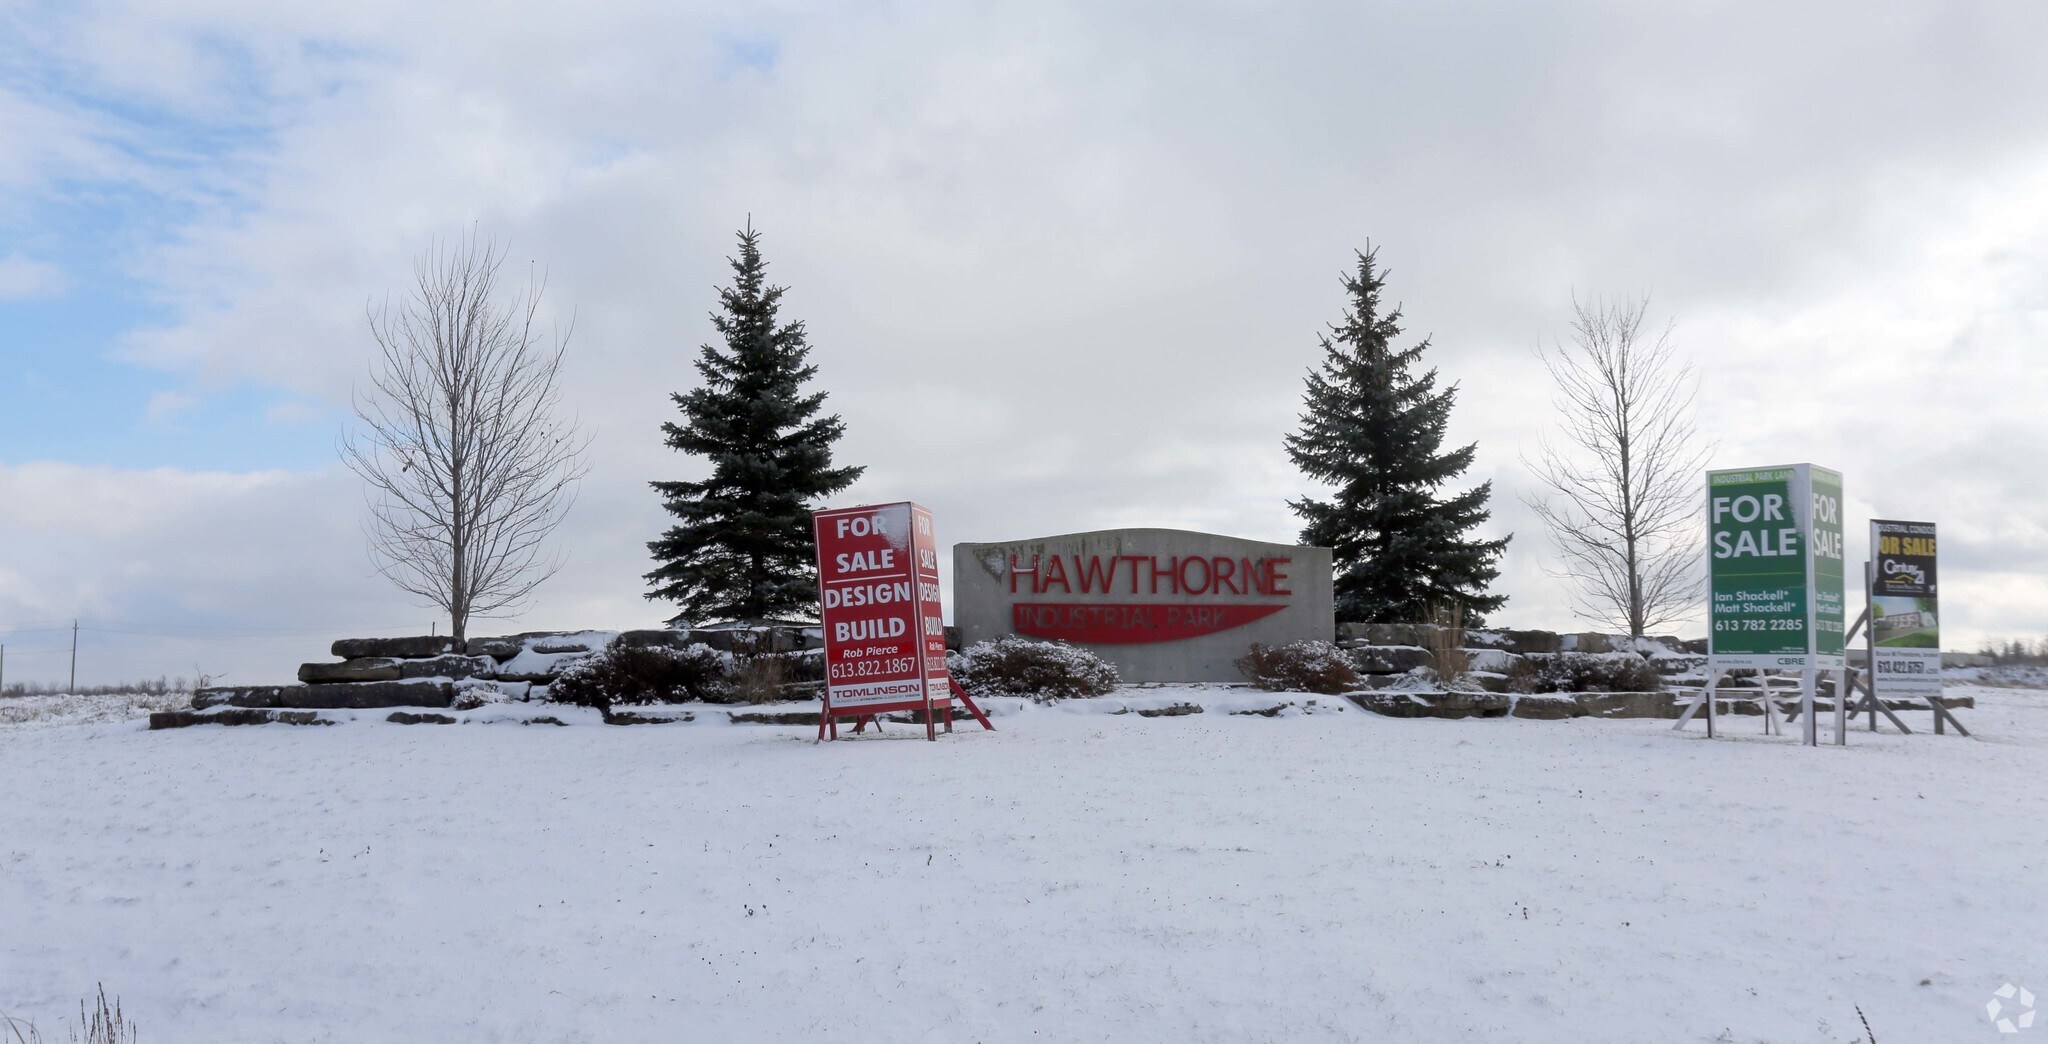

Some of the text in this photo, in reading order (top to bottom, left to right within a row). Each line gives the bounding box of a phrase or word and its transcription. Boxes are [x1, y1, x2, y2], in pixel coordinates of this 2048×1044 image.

[1713, 473, 1753, 484] INDUSTRIAL
[1755, 471, 1774, 481] PARK
[1713, 494, 1784, 524] FOR
[1813, 493, 1837, 525] FOR
[837, 515, 887, 539] FOR
[918, 516, 931, 536] FOR
[1714, 528, 1797, 558] SALE
[1814, 528, 1842, 560] SALE
[1880, 536, 1936, 556] OR SALE
[836, 549, 894, 573] SALE
[921, 548, 935, 570] SALE
[1884, 559, 1918, 575] Century
[1010, 554, 1292, 595] HAWTHORNE
[1914, 570, 1925, 584] 21
[825, 582, 911, 608] DESIGN
[1715, 592, 1733, 601] Ian
[1018, 606, 1227, 629] INDUSTRIAL PARK
[1715, 603, 1740, 613] Matt
[835, 617, 906, 642] BUILD
[925, 616, 943, 635] BUILD
[1715, 619, 1803, 631] 613 782 2285
[843, 645, 898, 659] Rob Pierce
[831, 657, 915, 678] 613.822.1867
[834, 684, 920, 698] TOMLINSON
